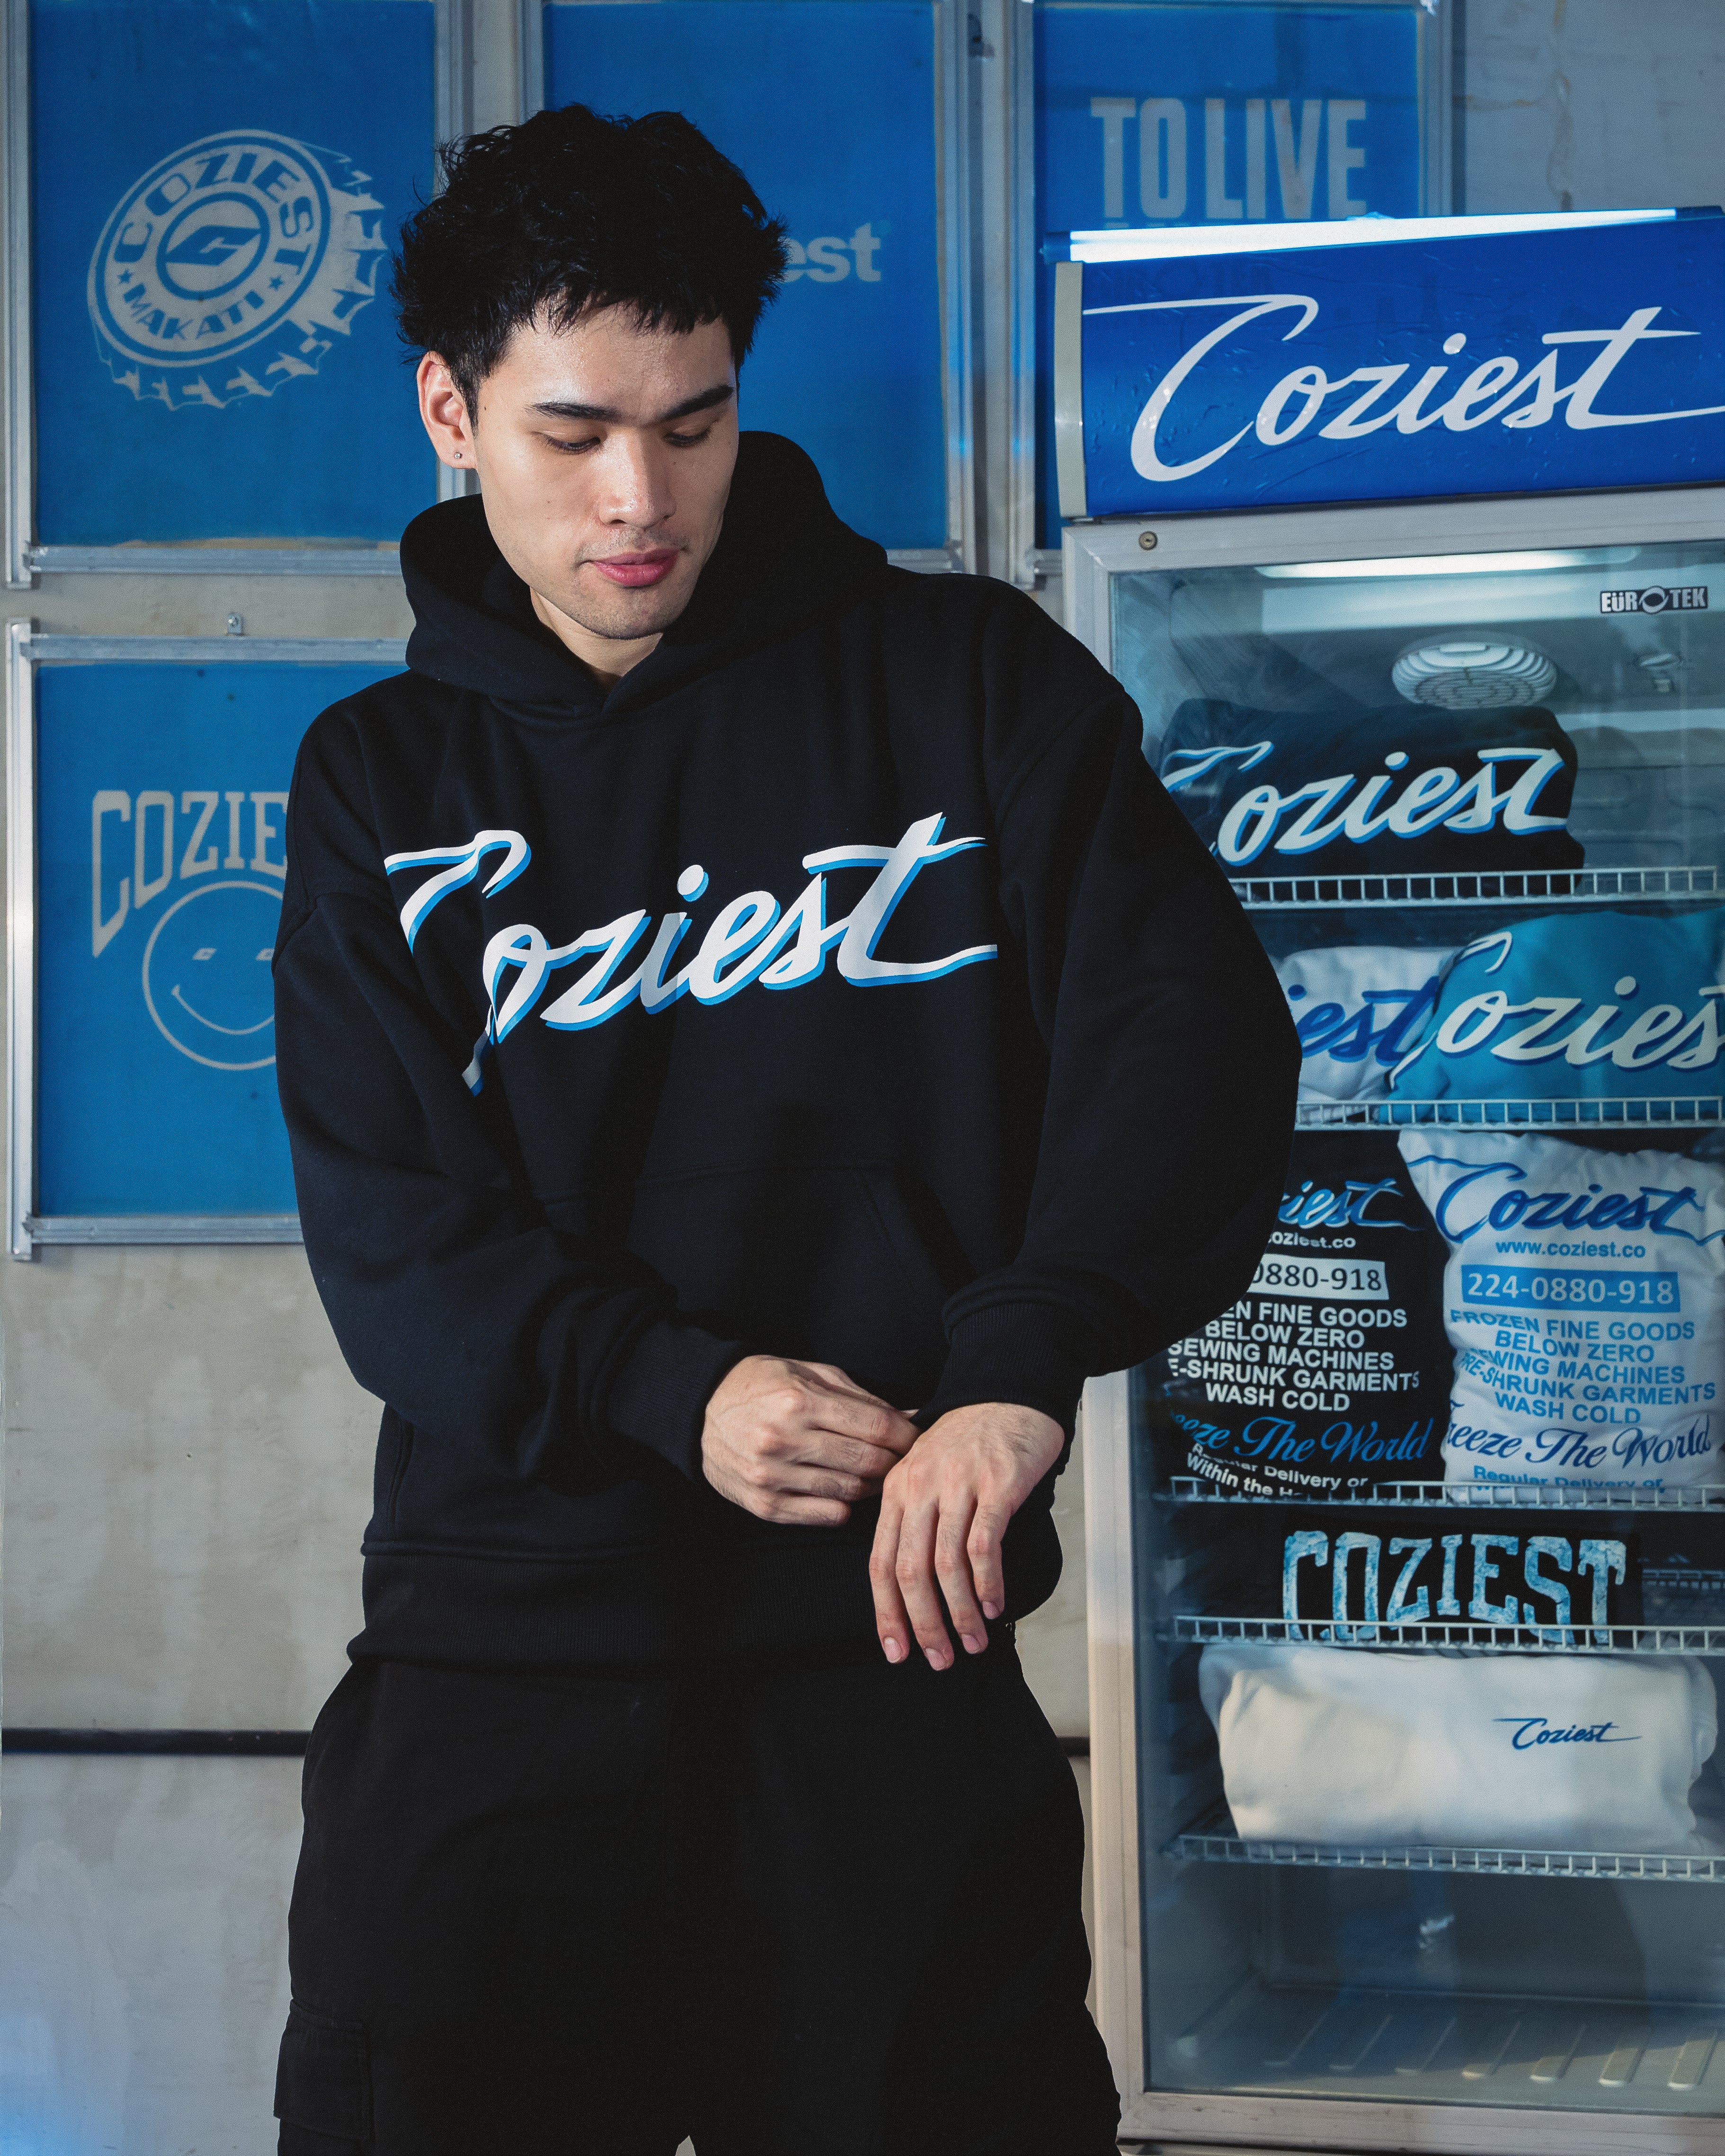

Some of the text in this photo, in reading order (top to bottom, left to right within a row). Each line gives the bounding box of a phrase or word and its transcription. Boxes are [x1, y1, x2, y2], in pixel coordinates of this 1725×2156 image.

[1090, 96, 1367, 220] TO LIVE
[113, 151, 314, 275] COZIEST
[122, 284, 266, 341] MAKATI
[1083, 293, 1725, 482] Coziest
[384, 811, 998, 1097] Coziest
[1389, 931, 1725, 1091] Cozies
[1407, 1155, 1725, 1246] Coziest
[1269, 1232, 1356, 1249] oziest.co
[1495, 1240, 1646, 1259] www.coziest.co
[1467, 1272, 1674, 1304] 224-0880-918
[1259, 1302, 1313, 1325] FINE
[1319, 1307, 1407, 1328] GOODS
[1450, 1309, 1695, 1341] FROZEN FINE GOODS
[1205, 1320, 1365, 1349] BELOW ZERO
[1495, 1330, 1655, 1363] BELOW ZERO
[1267, 1344, 1394, 1371] MACHINES
[1469, 1348, 1686, 1384] EWING MACHINES
[1205, 1382, 1350, 1412] WASH COLD
[1293, 1369, 1420, 1392] GARMENTS
[1582, 1382, 1716, 1405] GARMENTS
[1494, 1391, 1641, 1424] WASH COLD
[1234, 1416, 1316, 1463] The
[1320, 1417, 1434, 1464] World
[1525, 1428, 1608, 1469] The
[1612, 1414, 1712, 1468] World
[1187, 1452, 1274, 1496] Within the
[1263, 1465, 1342, 1491] Delivery
[1347, 1477, 1369, 1488] or
[1282, 1530, 1627, 1645] COZIEST
[1492, 1718, 1642, 1750] Coziest
